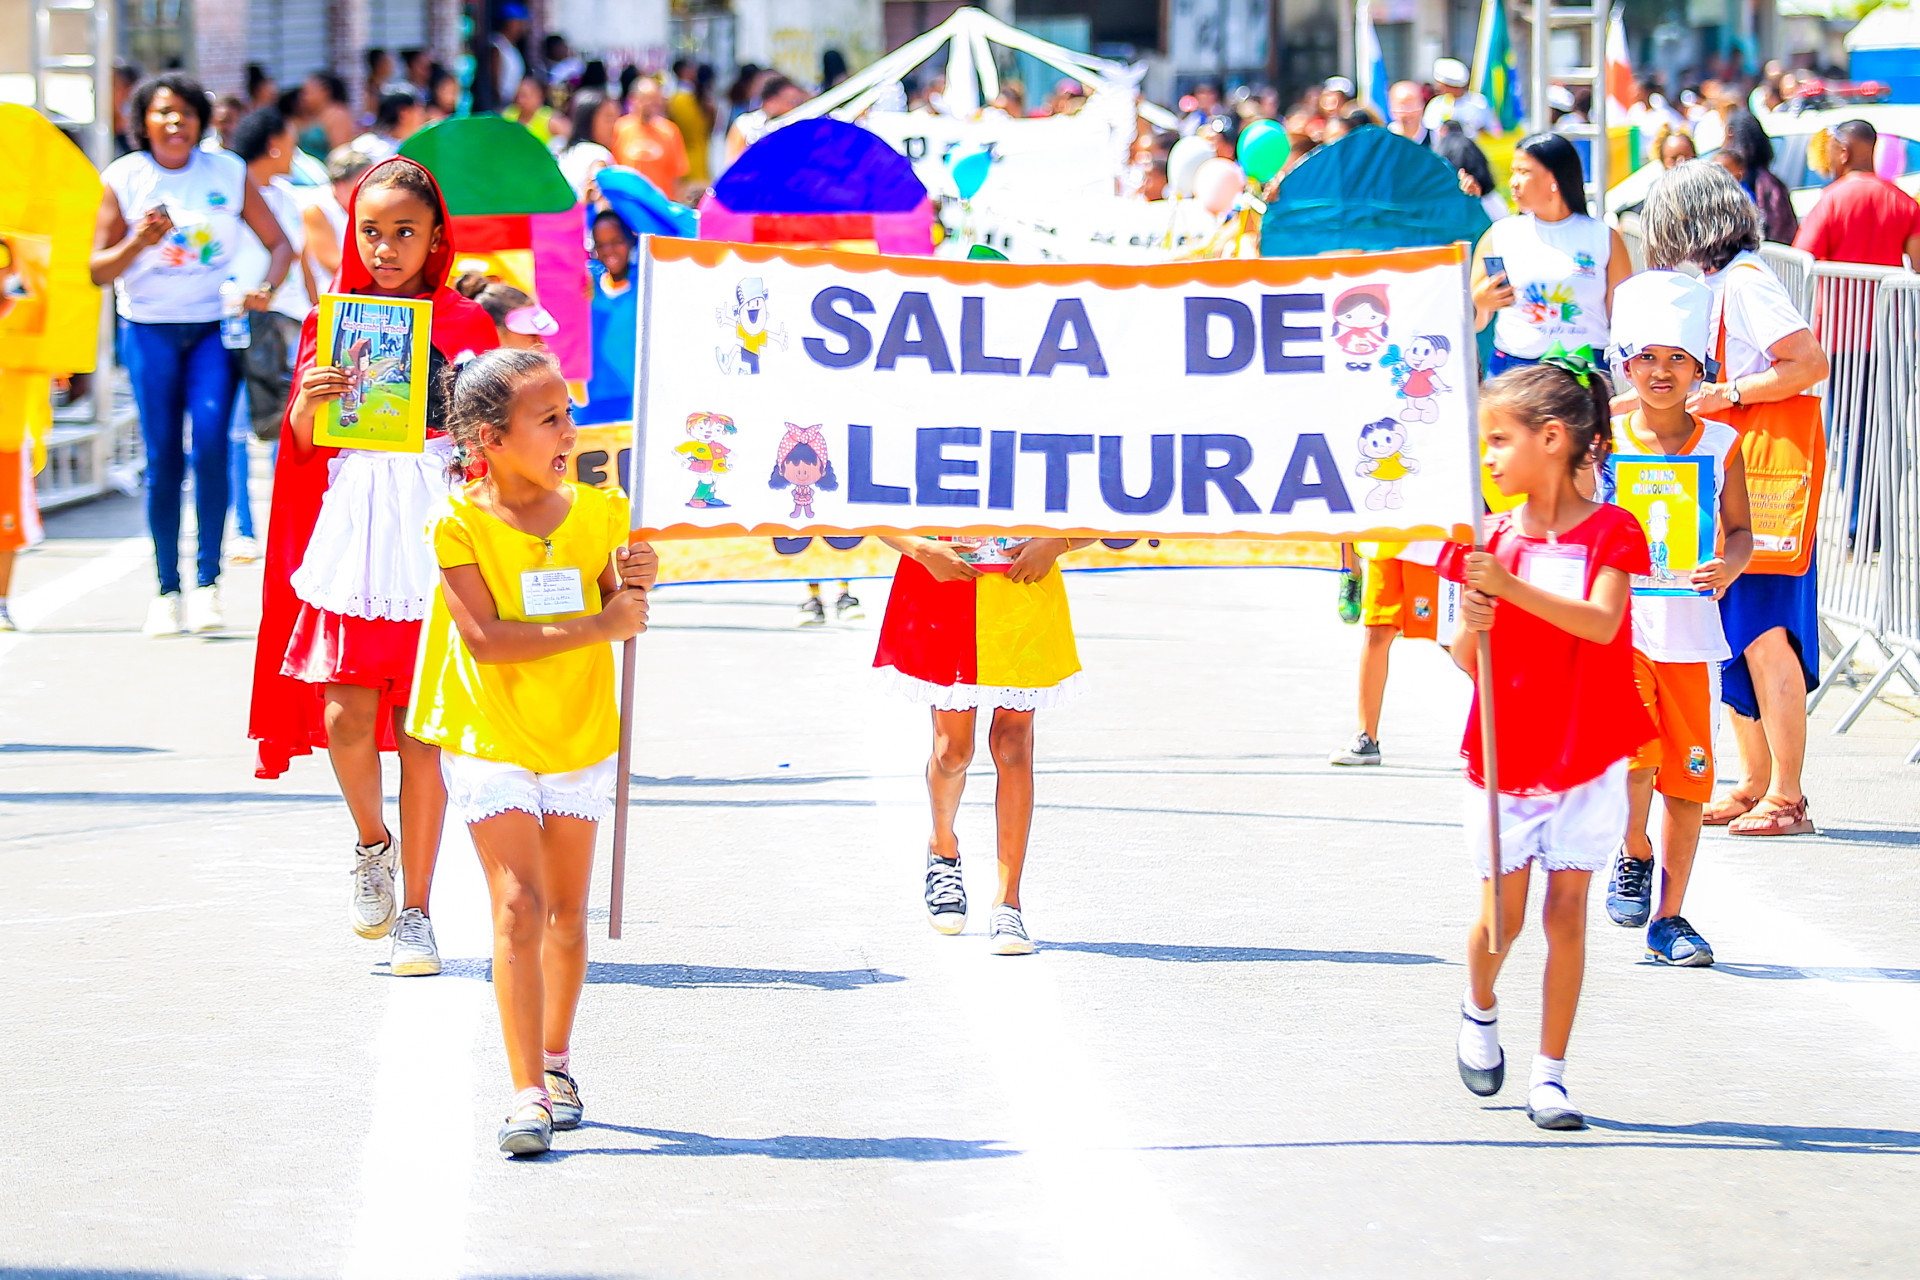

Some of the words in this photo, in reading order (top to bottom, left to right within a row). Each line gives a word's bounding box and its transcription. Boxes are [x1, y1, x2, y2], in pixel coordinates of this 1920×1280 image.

[802, 285, 1109, 378] SALA
[1183, 293, 1326, 376] DE
[846, 423, 1357, 516] LEITURA
